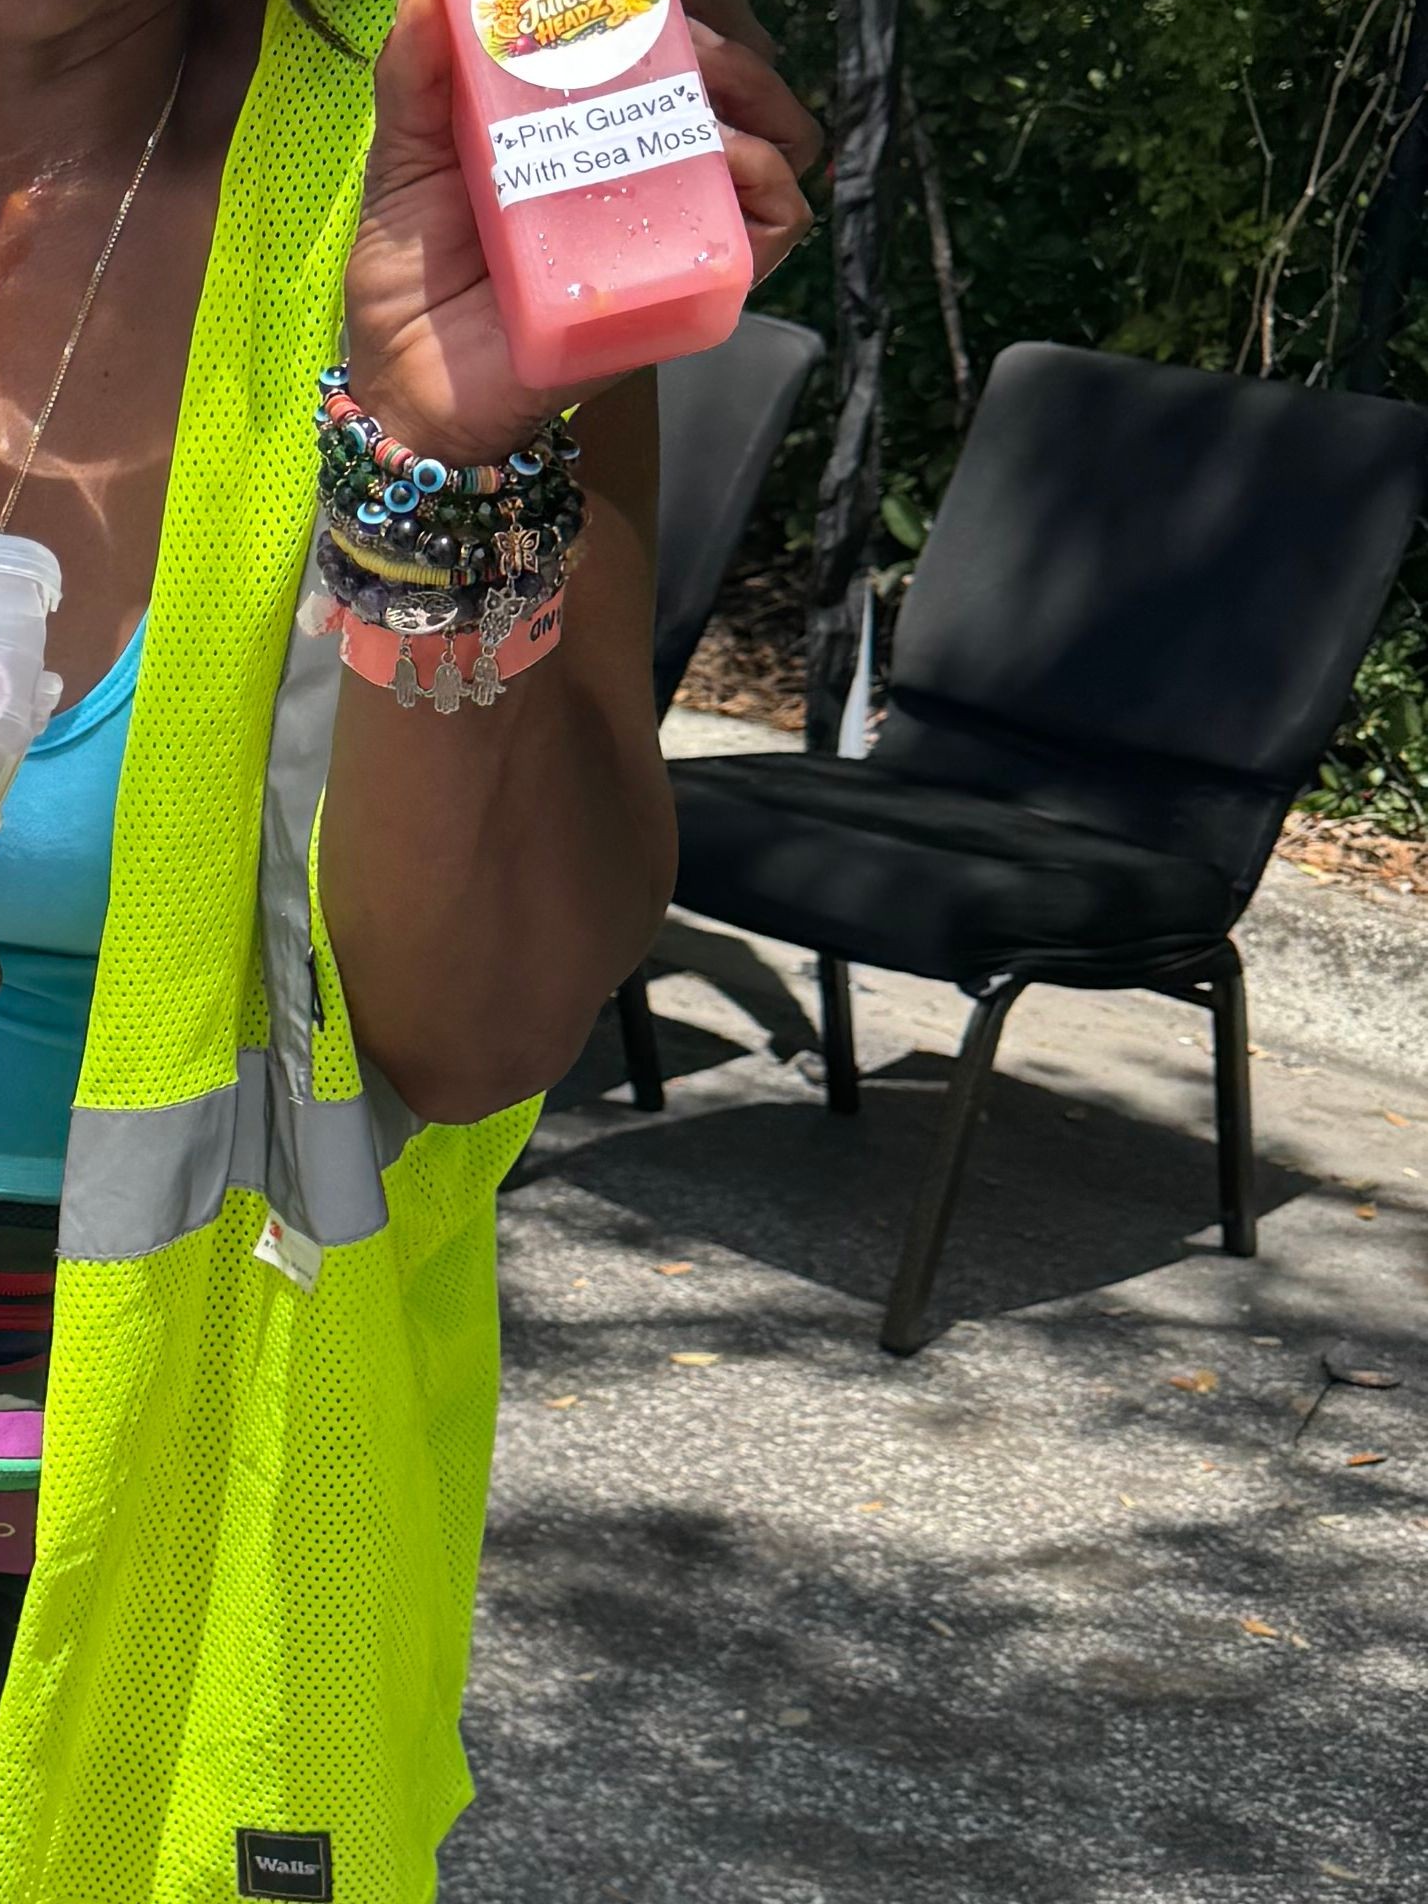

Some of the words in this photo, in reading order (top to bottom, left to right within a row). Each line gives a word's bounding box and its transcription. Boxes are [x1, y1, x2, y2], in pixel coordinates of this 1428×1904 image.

[518, 117, 580, 148] Pink
[586, 93, 676, 131] Guava
[504, 157, 567, 190] With
[573, 146, 631, 174] Sea
[637, 122, 712, 158] Moss
